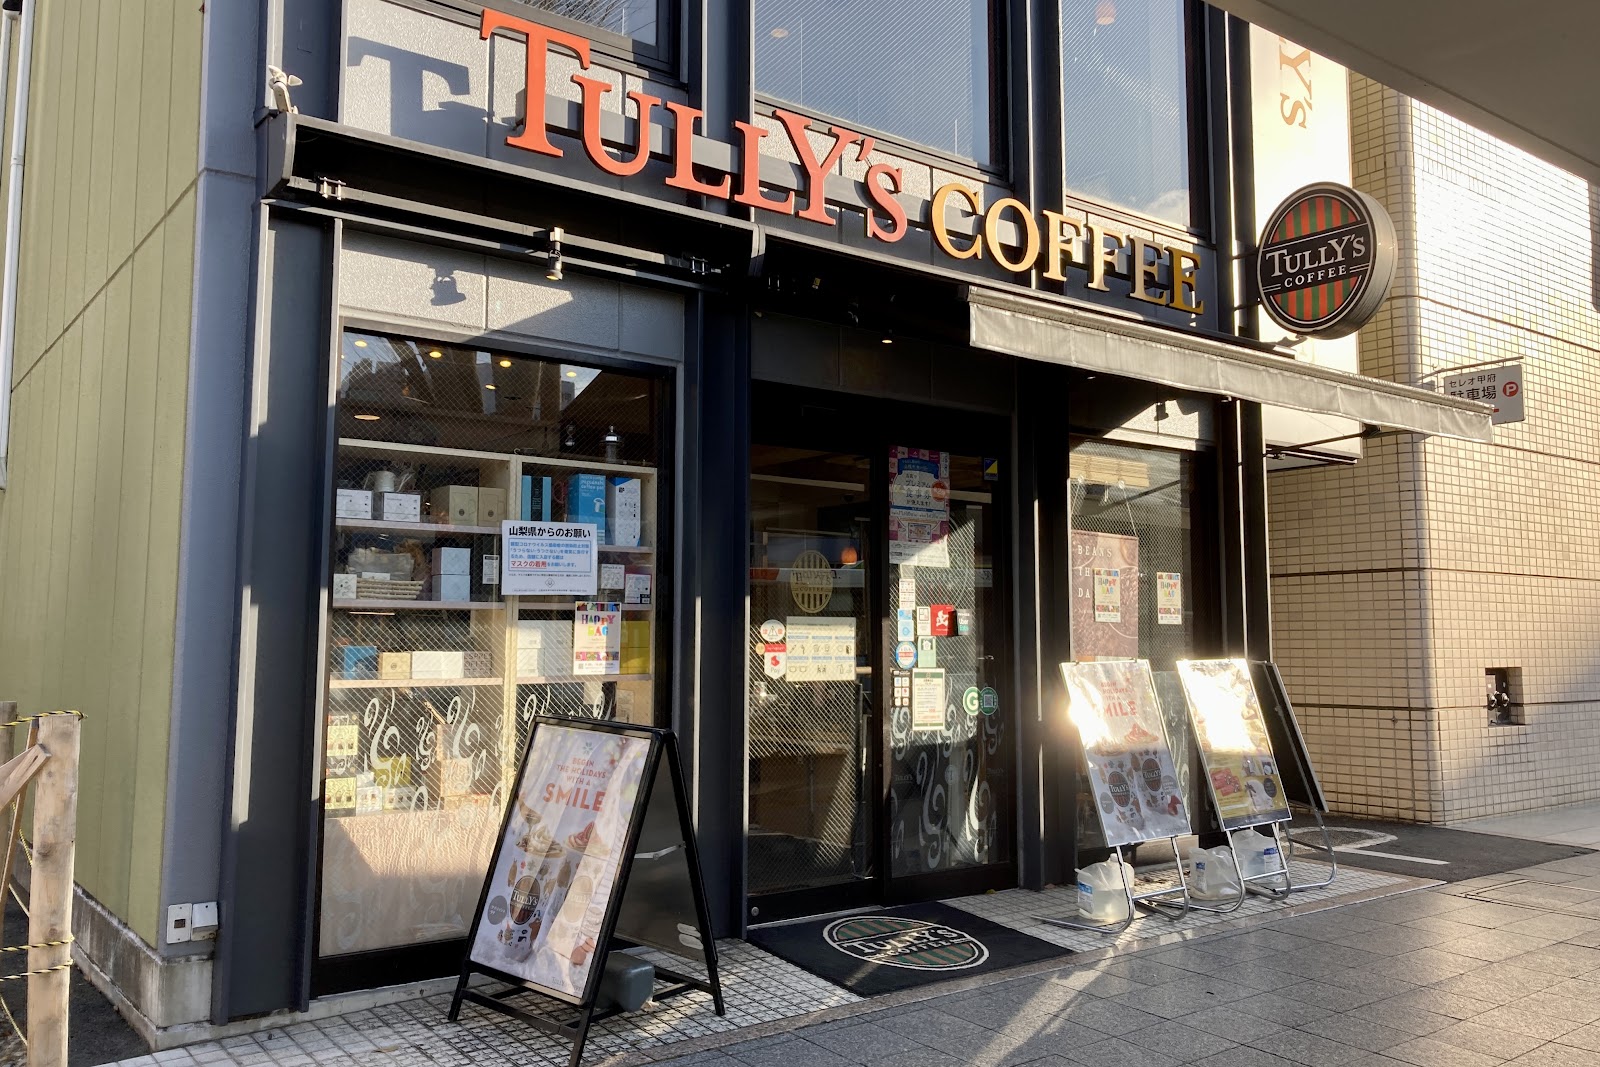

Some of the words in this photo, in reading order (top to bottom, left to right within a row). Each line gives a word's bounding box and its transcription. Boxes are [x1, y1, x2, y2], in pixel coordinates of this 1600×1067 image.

[480, 8, 907, 243] TULLY'S
[931, 183, 1204, 315] COFFEE
[1265, 234, 1366, 277] TULLY'S
[1284, 265, 1347, 288] COFFEE
[1449, 374, 1496, 388] セレオ甲府
[509, 526, 591, 538] 山梨県からのお願い
[1077, 545, 1112, 558] BEANS
[581, 614, 616, 625] HAPPY
[587, 625, 609, 636] BAG
[572, 757, 595, 767] BEGIN
[557, 764, 569, 773] THE
[570, 766, 607, 779] HOLIDAYS
[566, 775, 585, 784] WITH
[543, 782, 607, 812] SMILE
[886, 940, 952, 956] COFFEE
